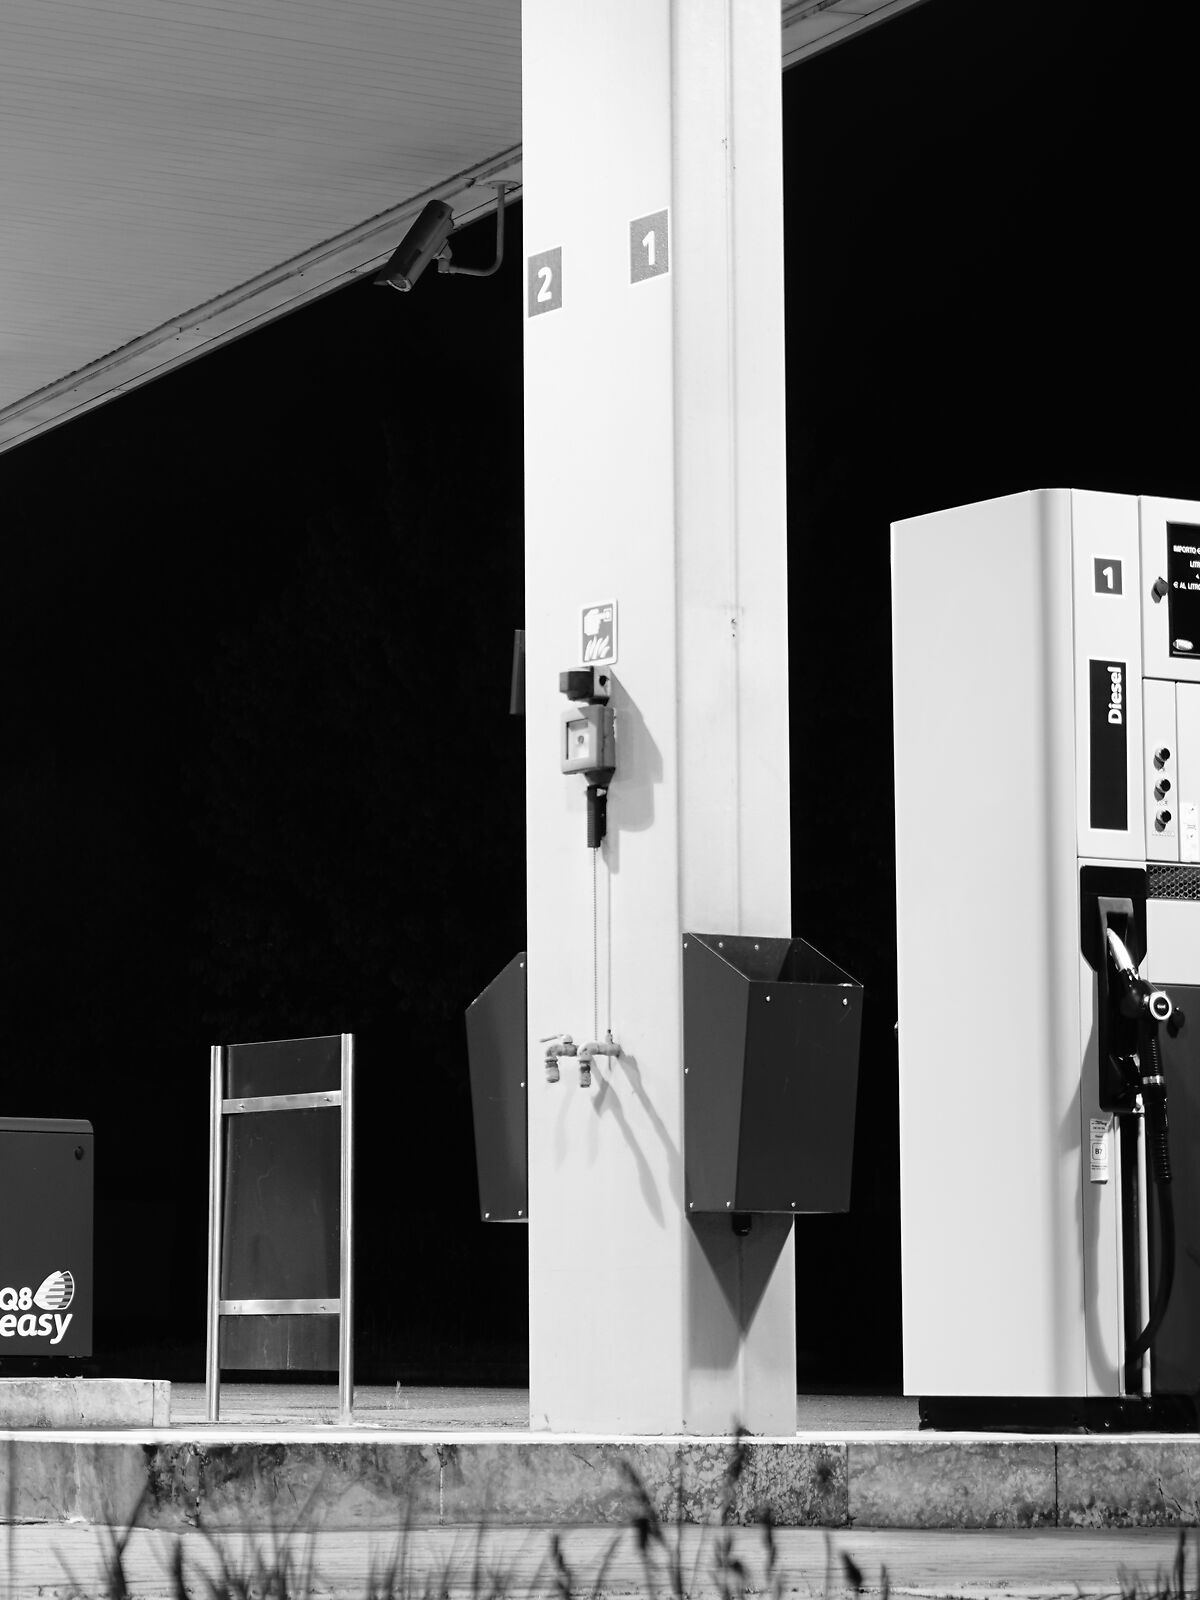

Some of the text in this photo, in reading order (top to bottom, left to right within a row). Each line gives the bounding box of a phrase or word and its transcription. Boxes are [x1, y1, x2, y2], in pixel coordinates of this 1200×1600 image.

[641, 231, 655, 266] 1
[537, 266, 552, 303] 2
[1102, 566, 1114, 590] 1
[1107, 666, 1122, 725] Diesel
